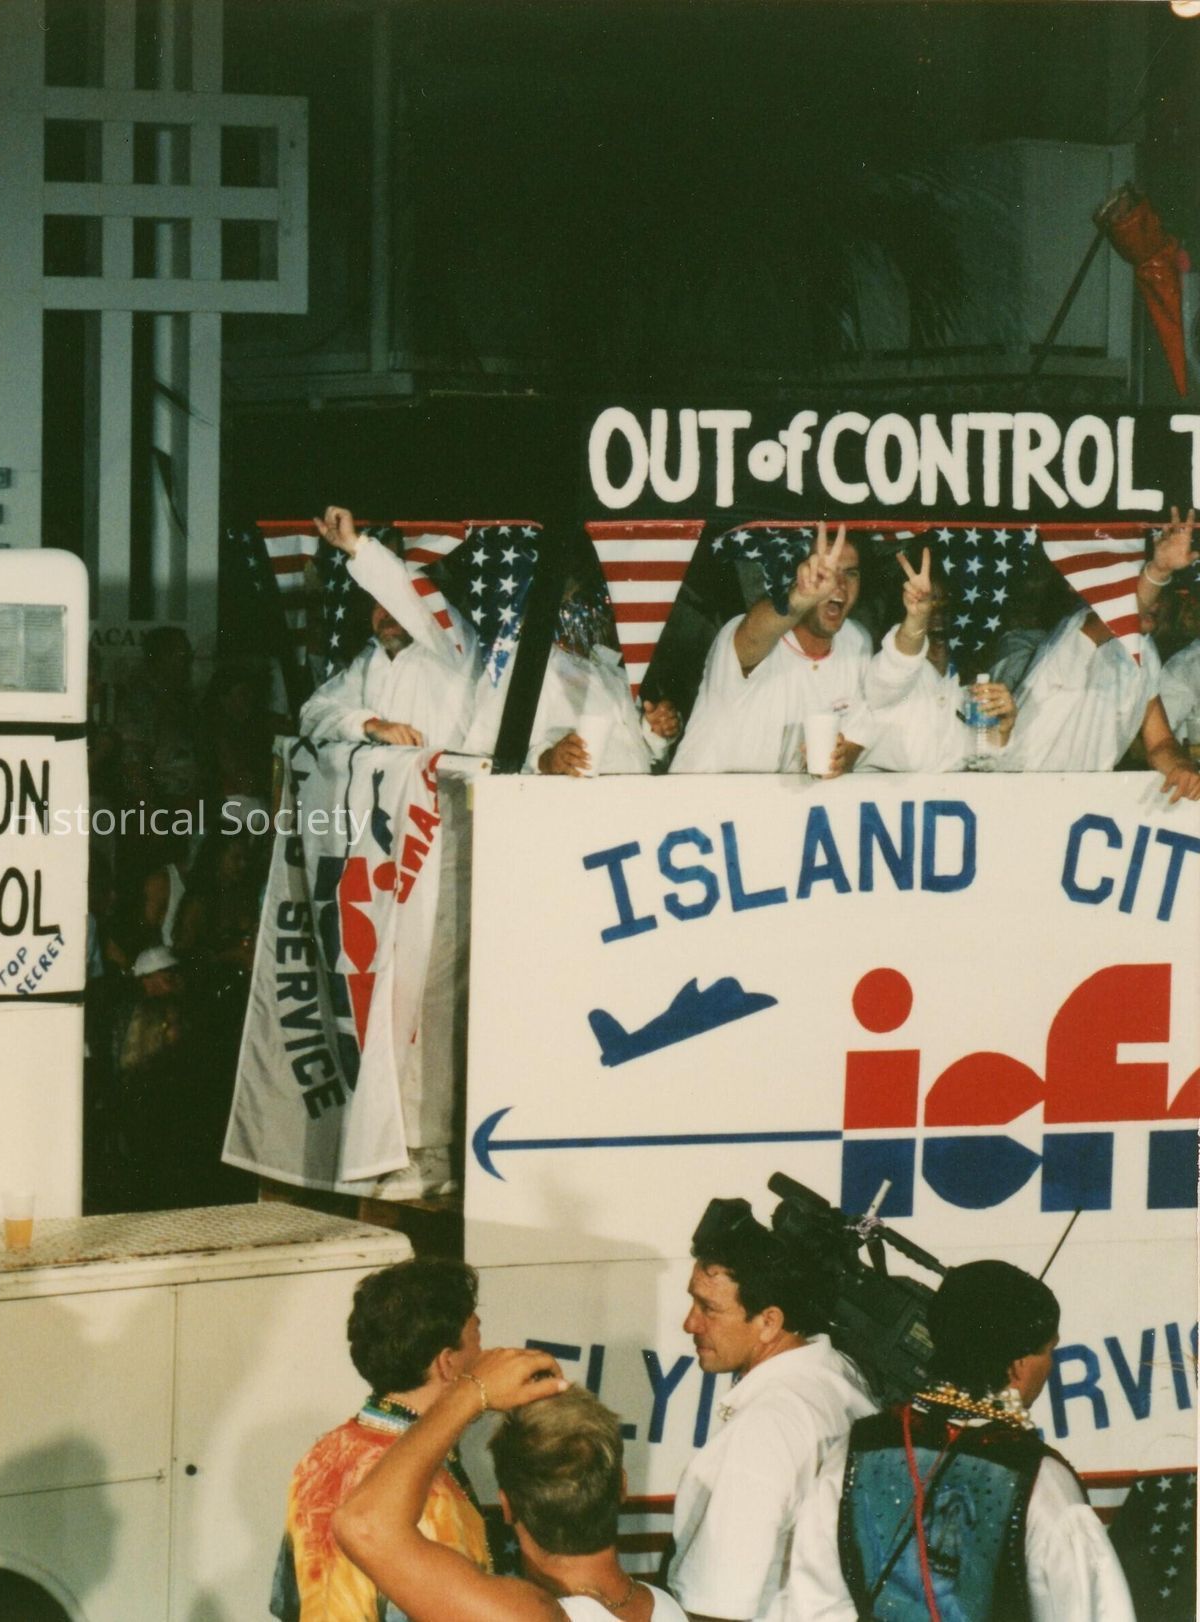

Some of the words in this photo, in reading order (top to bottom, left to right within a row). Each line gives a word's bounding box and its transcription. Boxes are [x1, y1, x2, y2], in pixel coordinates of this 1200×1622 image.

[589, 407, 751, 509] OUT
[747, 411, 818, 493] of
[817, 411, 1164, 512] CONTROL
[583, 800, 977, 943] ISLAND
[16, 932, 65, 996] SECRET
[276, 901, 347, 1120] SERVICE
